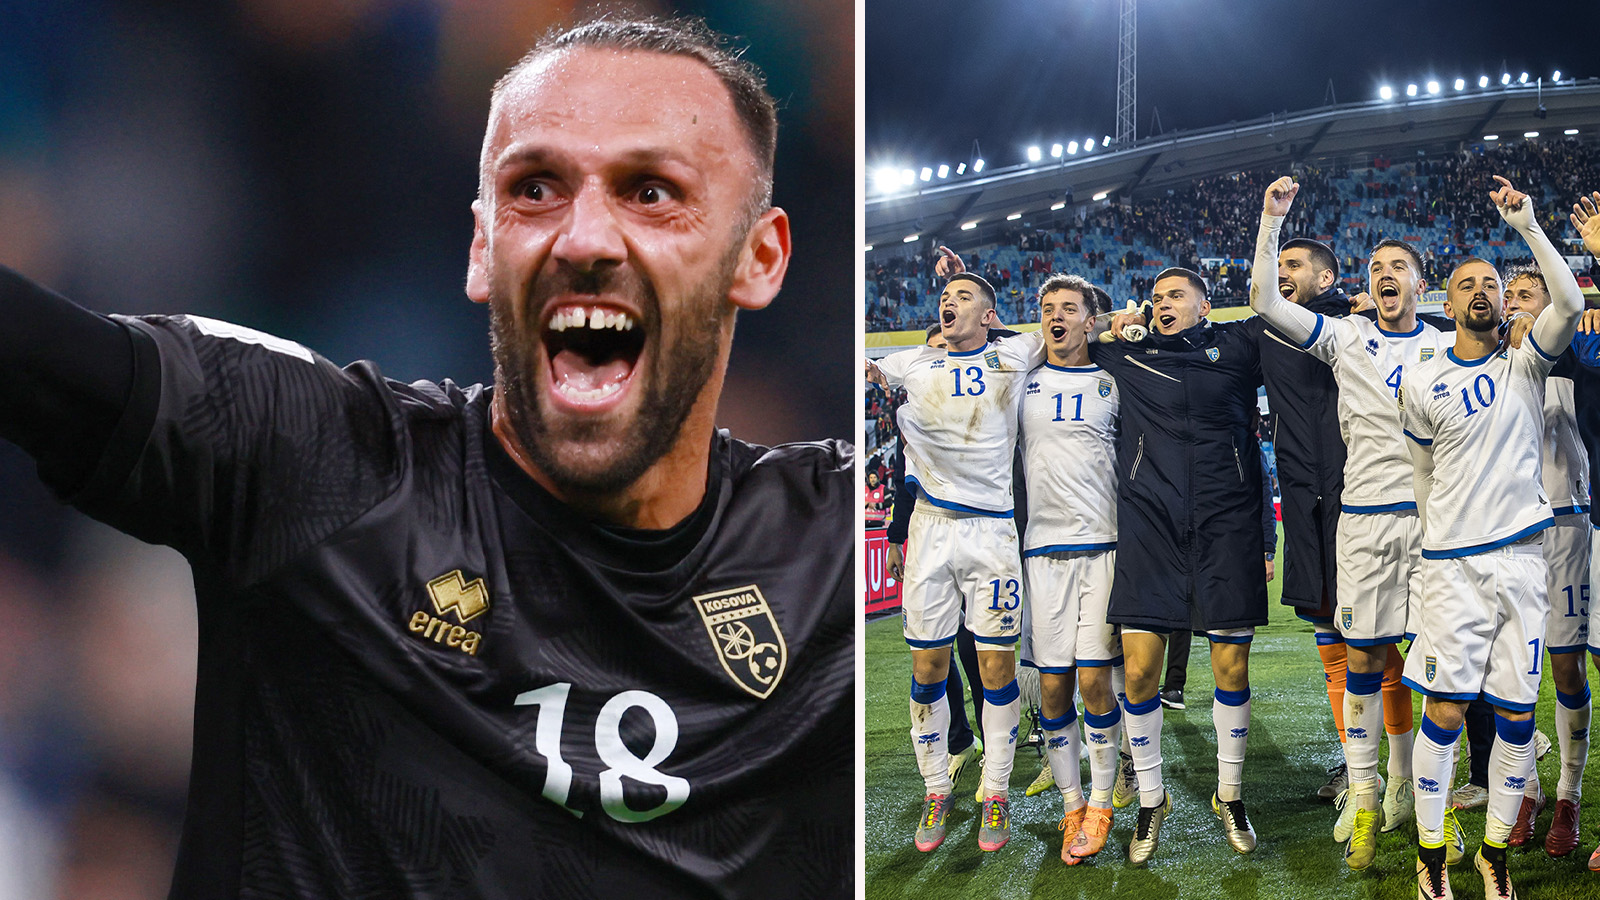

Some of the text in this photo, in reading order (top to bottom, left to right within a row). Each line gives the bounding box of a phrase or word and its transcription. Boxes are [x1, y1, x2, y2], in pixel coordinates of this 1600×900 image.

[949, 366, 986, 397] 13
[1385, 364, 1403, 398] 4
[1460, 373, 1496, 418] 10
[1051, 393, 1085, 422] 11
[703, 592, 757, 613] KOSOVA
[988, 578, 1020, 610] 13
[1561, 584, 1590, 617] 15
[409, 610, 482, 656] errea
[1527, 637, 1546, 675] 1
[513, 682, 691, 823] 18
